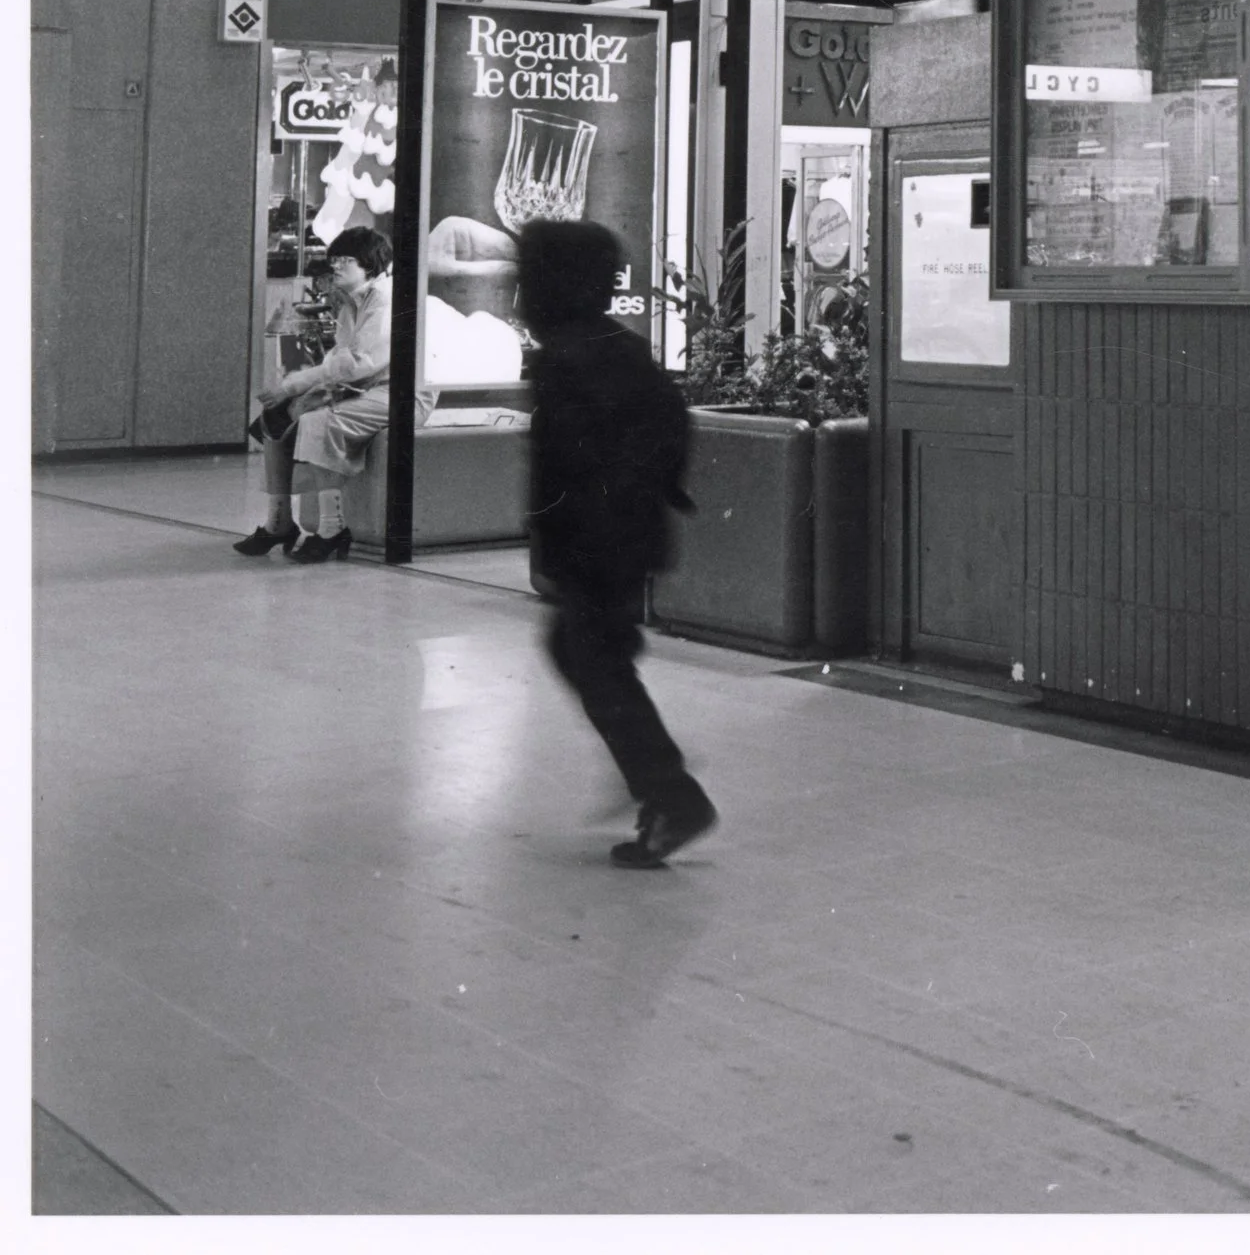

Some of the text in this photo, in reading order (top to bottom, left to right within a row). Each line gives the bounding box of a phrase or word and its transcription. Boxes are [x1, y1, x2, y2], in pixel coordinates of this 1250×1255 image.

[467, 15, 628, 69] Regardez
[473, 57, 619, 102] le cristal.
[922, 262, 989, 274] FIRE HOSE REEL
